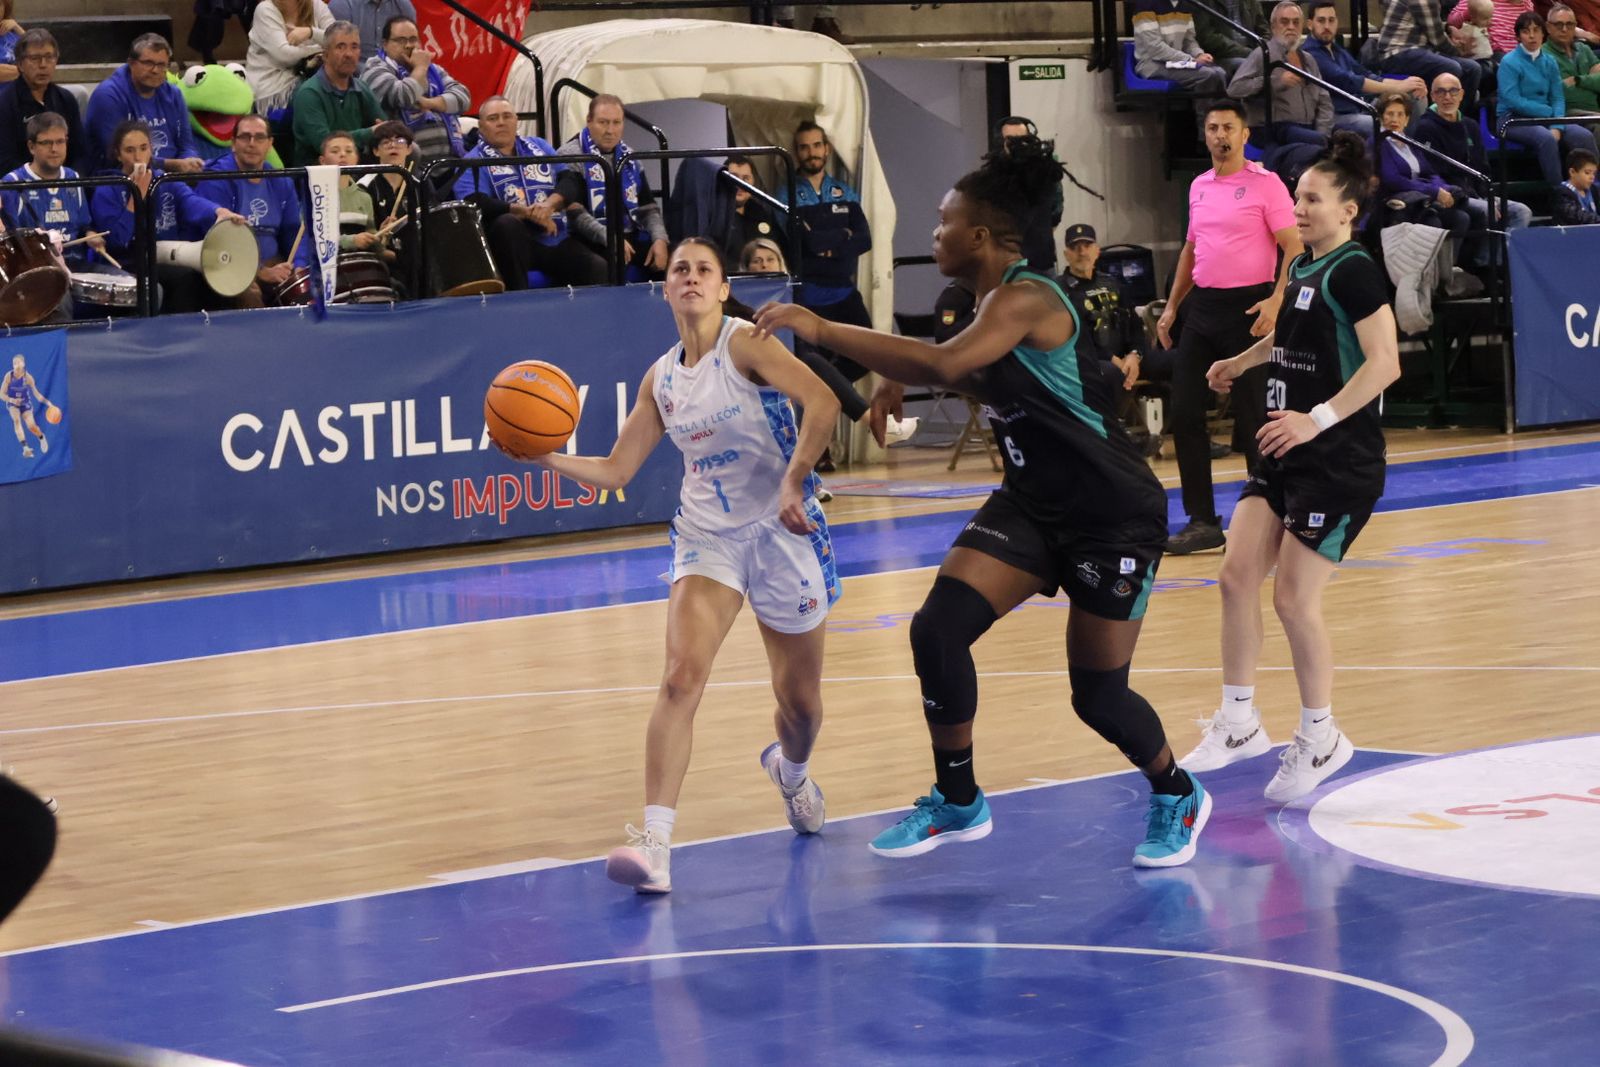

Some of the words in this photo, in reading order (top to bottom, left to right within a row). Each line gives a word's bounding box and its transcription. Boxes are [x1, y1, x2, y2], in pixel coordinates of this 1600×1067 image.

[1034, 66, 1063, 78] SALIDA
[1266, 377, 1287, 411] 20
[711, 404, 742, 424] LEÓN
[221, 395, 494, 473] CASTILL
[1004, 436, 1025, 467] 6
[377, 480, 446, 517] NOS
[712, 479, 731, 513] 1
